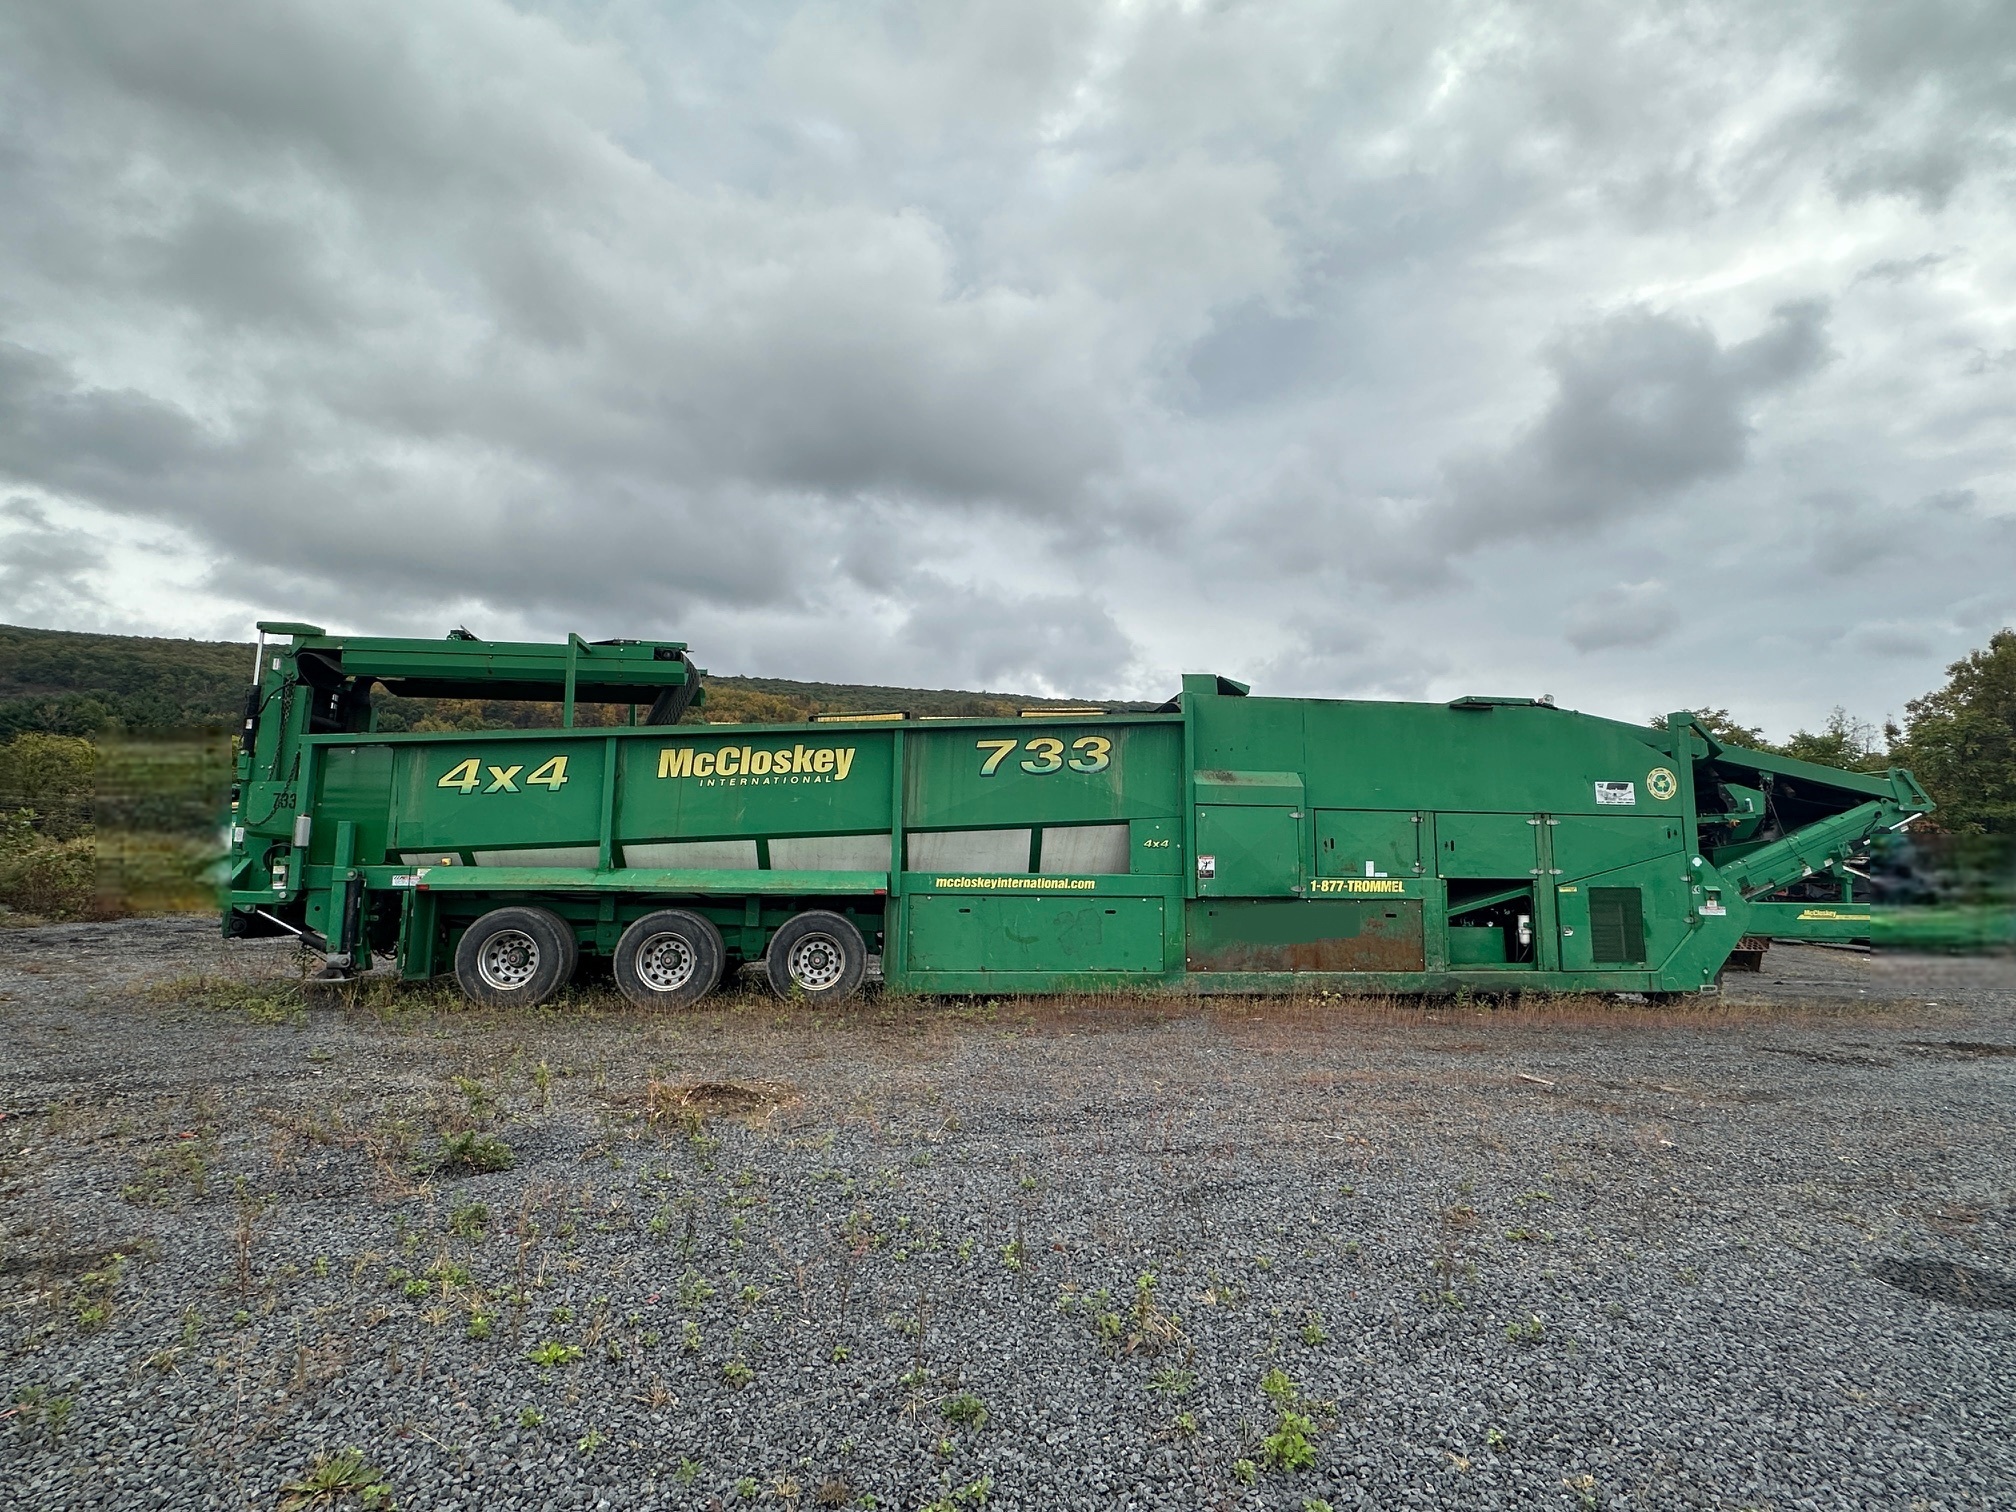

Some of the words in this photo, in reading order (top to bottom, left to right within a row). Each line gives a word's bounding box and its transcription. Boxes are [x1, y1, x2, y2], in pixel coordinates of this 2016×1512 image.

[657, 744, 856, 781] McCloskey
[976, 735, 1113, 776] 733
[437, 755, 569, 794] 4x4
[699, 775, 832, 787] INTERNATIONAL
[273, 793, 297, 809] 733
[1143, 838, 1169, 848] 4x4
[935, 876, 1096, 891] mccloskeyinternational.com
[1310, 880, 1405, 893] 1-877-TROMMEL
